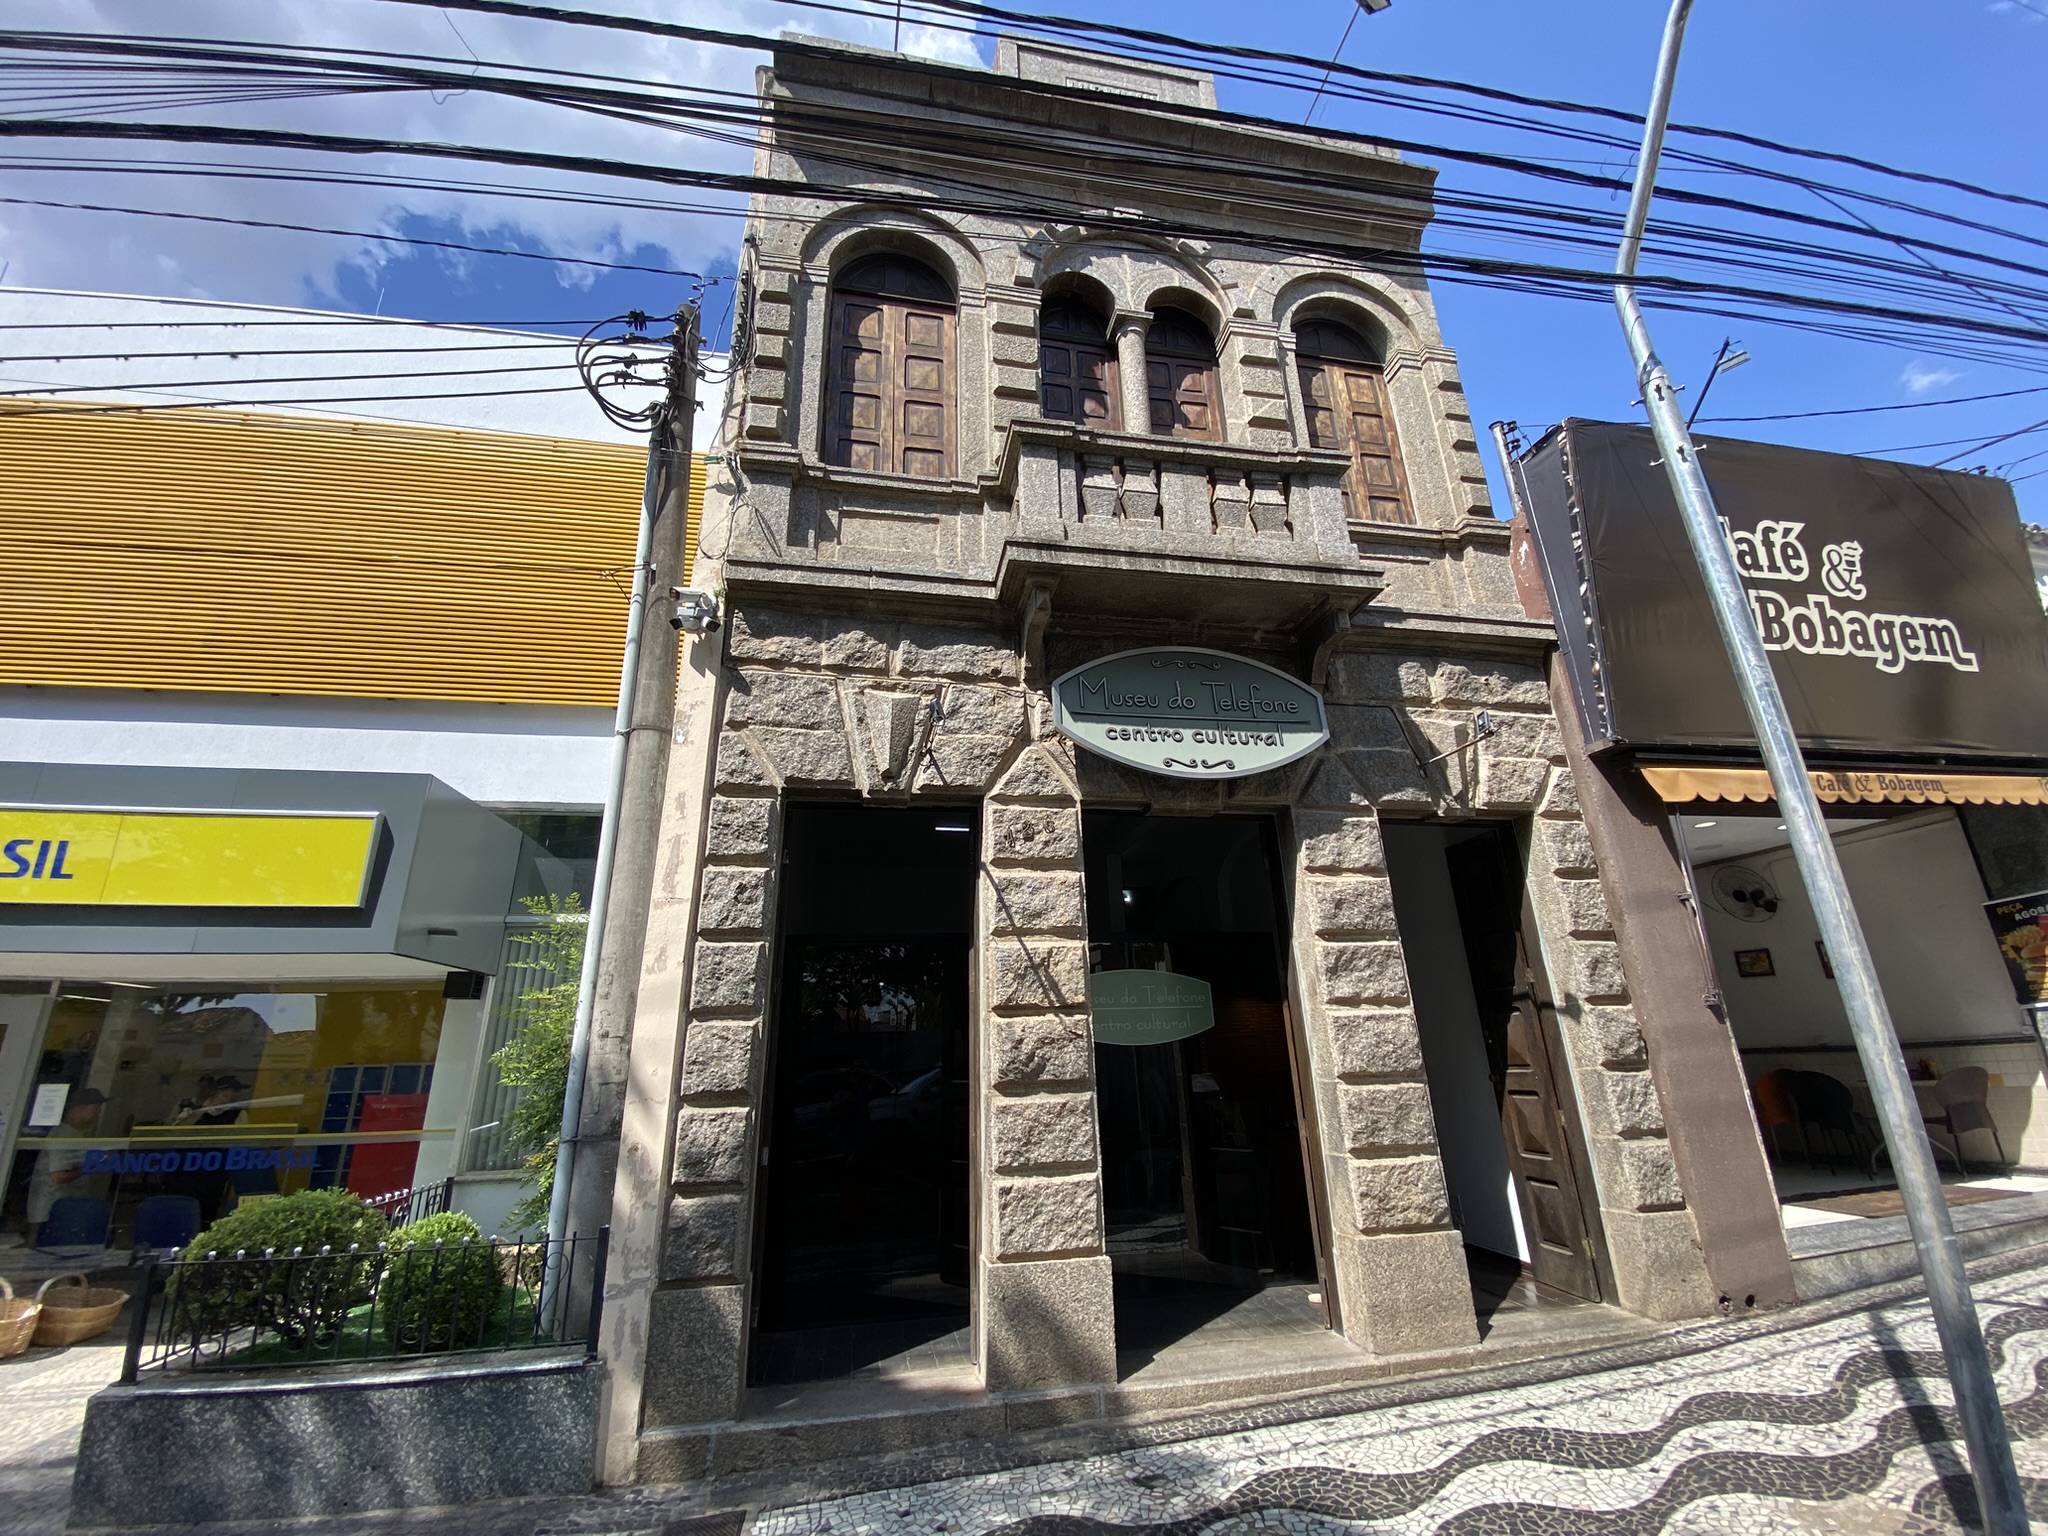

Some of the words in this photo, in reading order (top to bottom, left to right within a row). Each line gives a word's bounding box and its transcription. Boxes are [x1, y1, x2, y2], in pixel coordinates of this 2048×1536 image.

[1718, 516, 1809, 582] afé
[1821, 540, 1867, 600] &
[1748, 589, 1979, 673] Bobagem
[1078, 676, 1160, 709] Museu
[1168, 680, 1195, 710] do
[1201, 681, 1299, 718] Telefone
[1105, 722, 1184, 743] centro
[1191, 722, 1285, 747] cultural
[1815, 774, 1852, 792] Café
[1854, 773, 1873, 792] &
[1876, 774, 1949, 796] Bobagem
[0, 838, 74, 879] SIL
[1996, 902, 2024, 915] PEÇA
[2014, 904, 2048, 921] AGOR
[1120, 986, 1137, 1004] do
[1142, 985, 1205, 1006] Telefone
[1137, 1012, 1190, 1030] cultural
[82, 1149, 181, 1173] BANCO
[183, 1151, 222, 1172] DO
[225, 1147, 321, 1171] BRASIL
